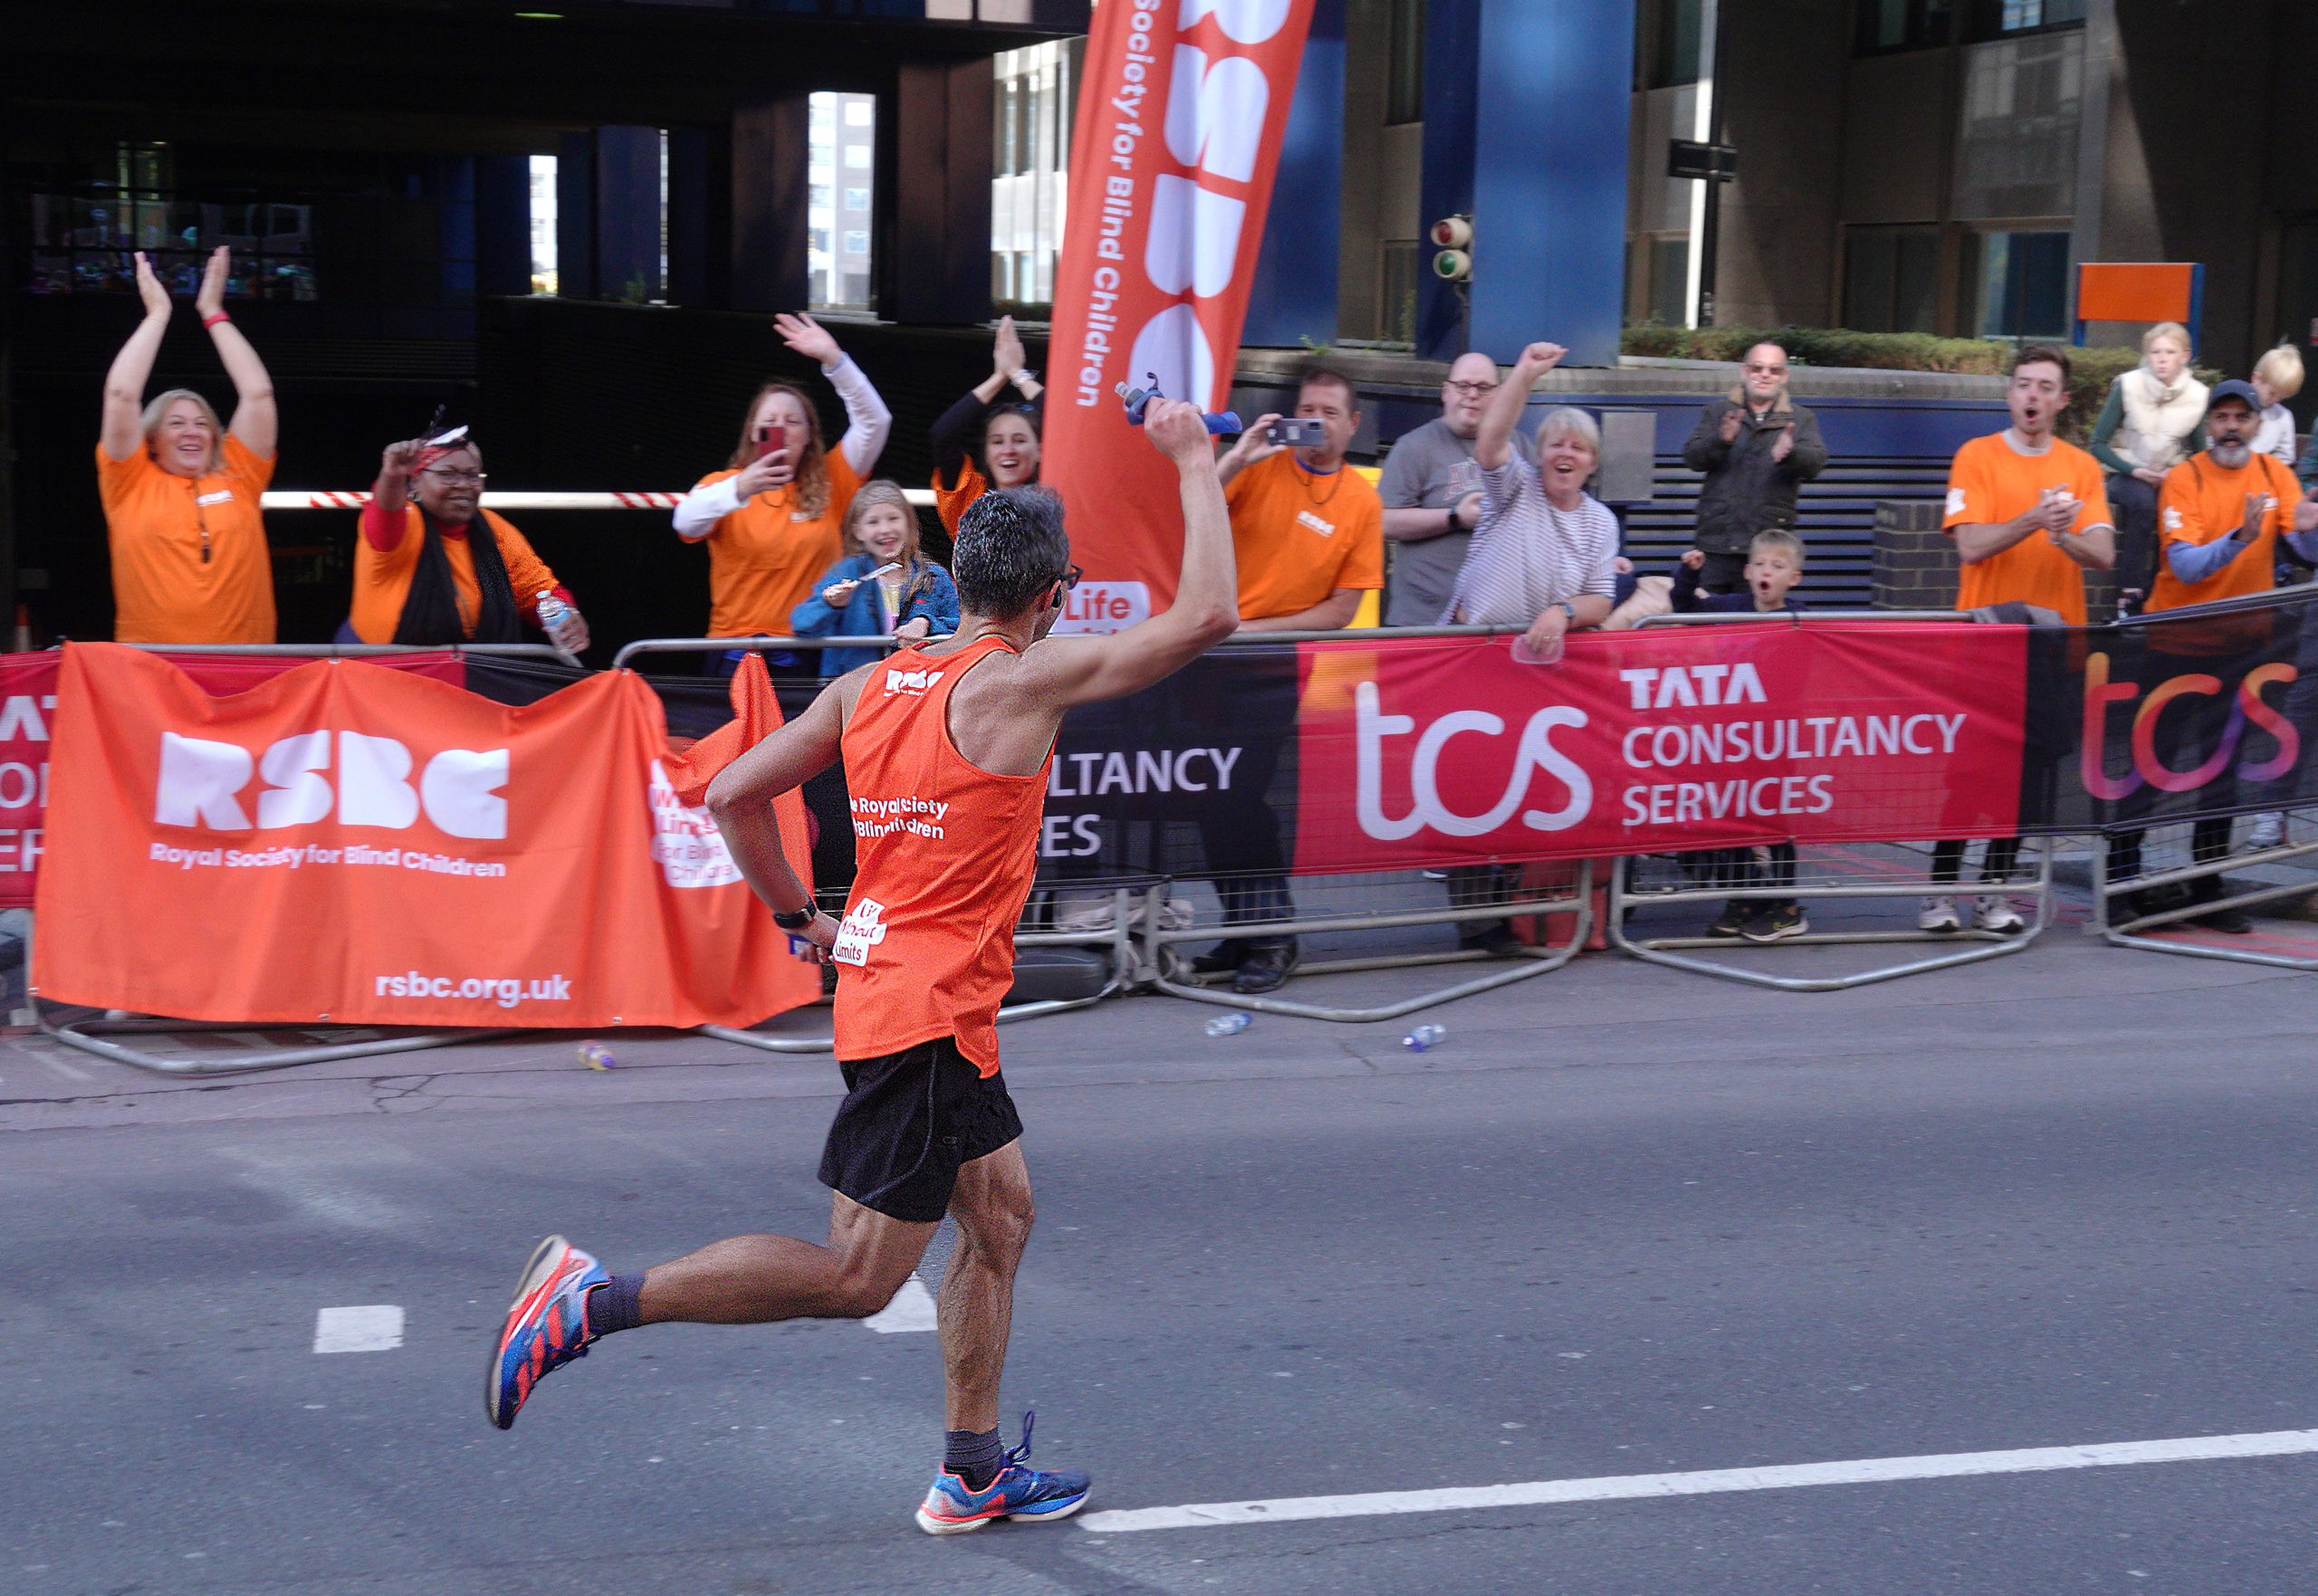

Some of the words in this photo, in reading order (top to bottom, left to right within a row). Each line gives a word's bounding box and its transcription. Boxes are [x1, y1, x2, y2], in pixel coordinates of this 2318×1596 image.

[1112, 122, 1144, 171] for
[1097, 176, 1134, 261] Blind
[1076, 267, 1121, 407] Children
[1064, 588, 1131, 620] Life
[1619, 663, 1767, 709] TATA
[1622, 712, 1967, 769] CONSULTANCY
[155, 729, 510, 840] RSBC
[1048, 747, 1243, 797] LTANCY
[1622, 774, 1834, 827] SERVICES
[149, 843, 223, 870] Royal
[225, 848, 306, 869] Society
[306, 844, 341, 865] for
[343, 844, 400, 866] Blind
[401, 851, 507, 877] Children
[376, 970, 571, 1008] rsbc.org.uk
